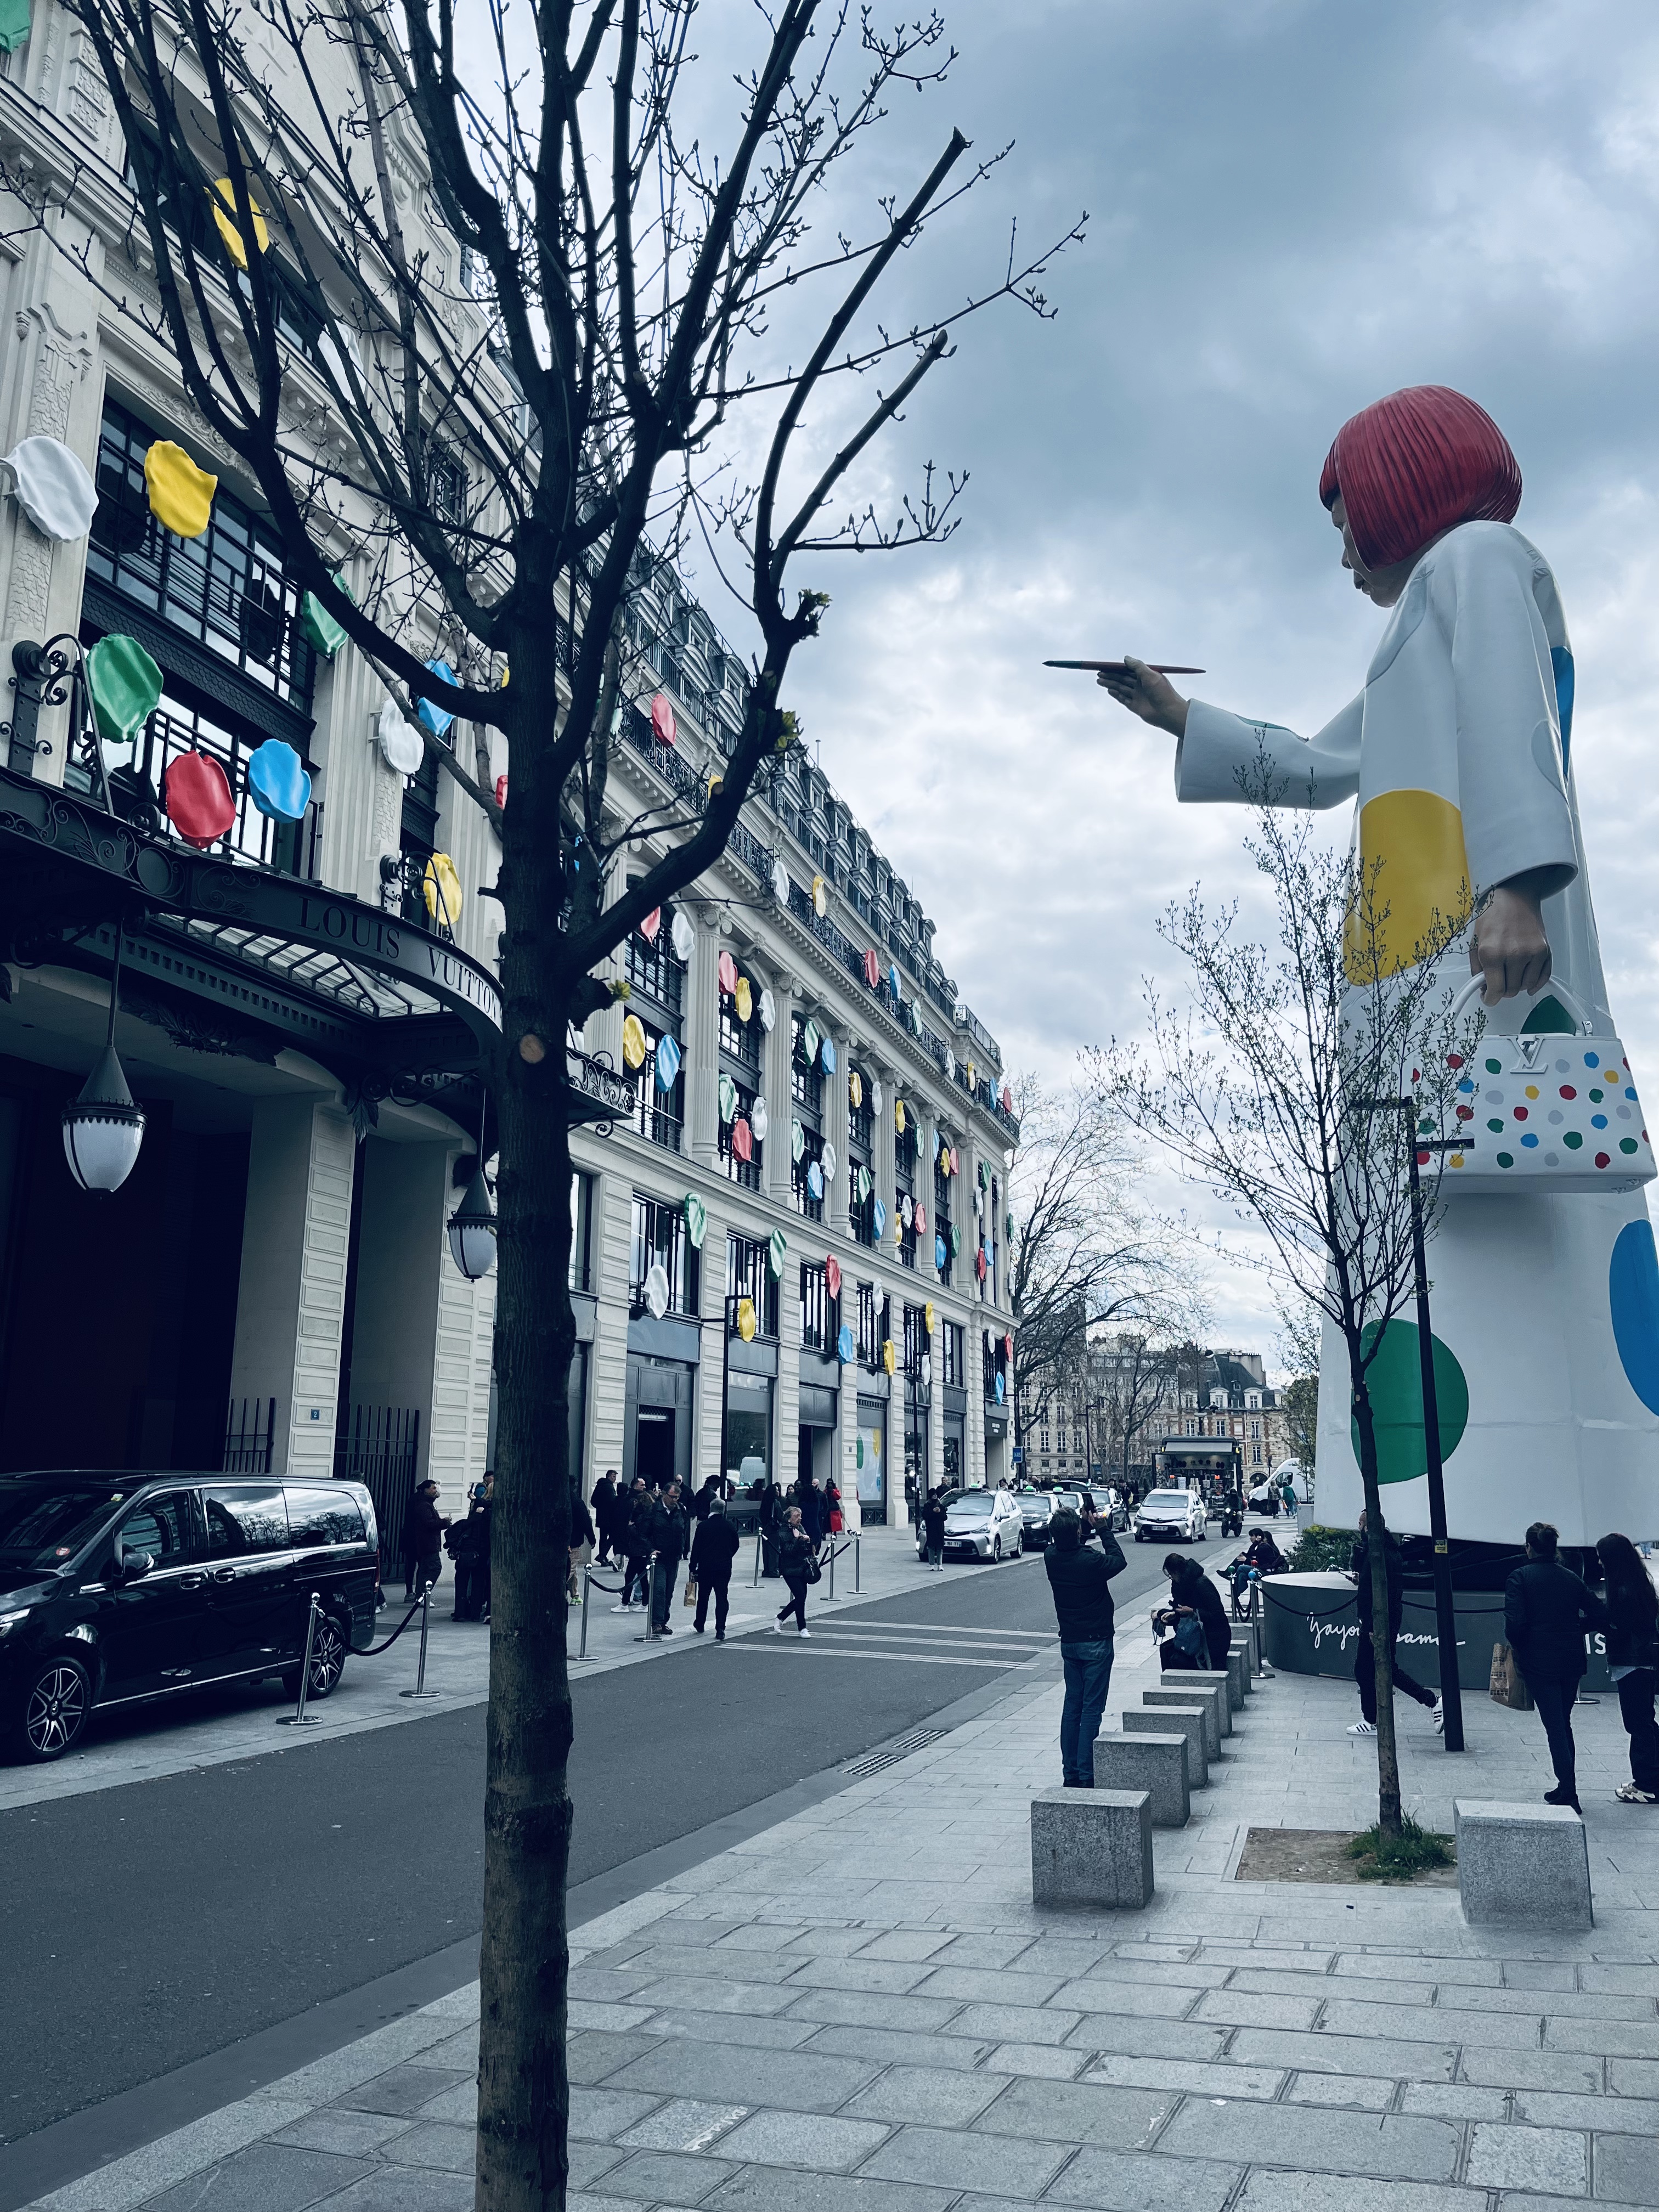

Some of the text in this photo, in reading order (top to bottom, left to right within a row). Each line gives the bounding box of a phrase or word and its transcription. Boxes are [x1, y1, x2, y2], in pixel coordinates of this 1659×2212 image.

[296, 896, 498, 1022] LOUIS VUITTON
[1306, 1612, 1362, 1651] Yayoi
